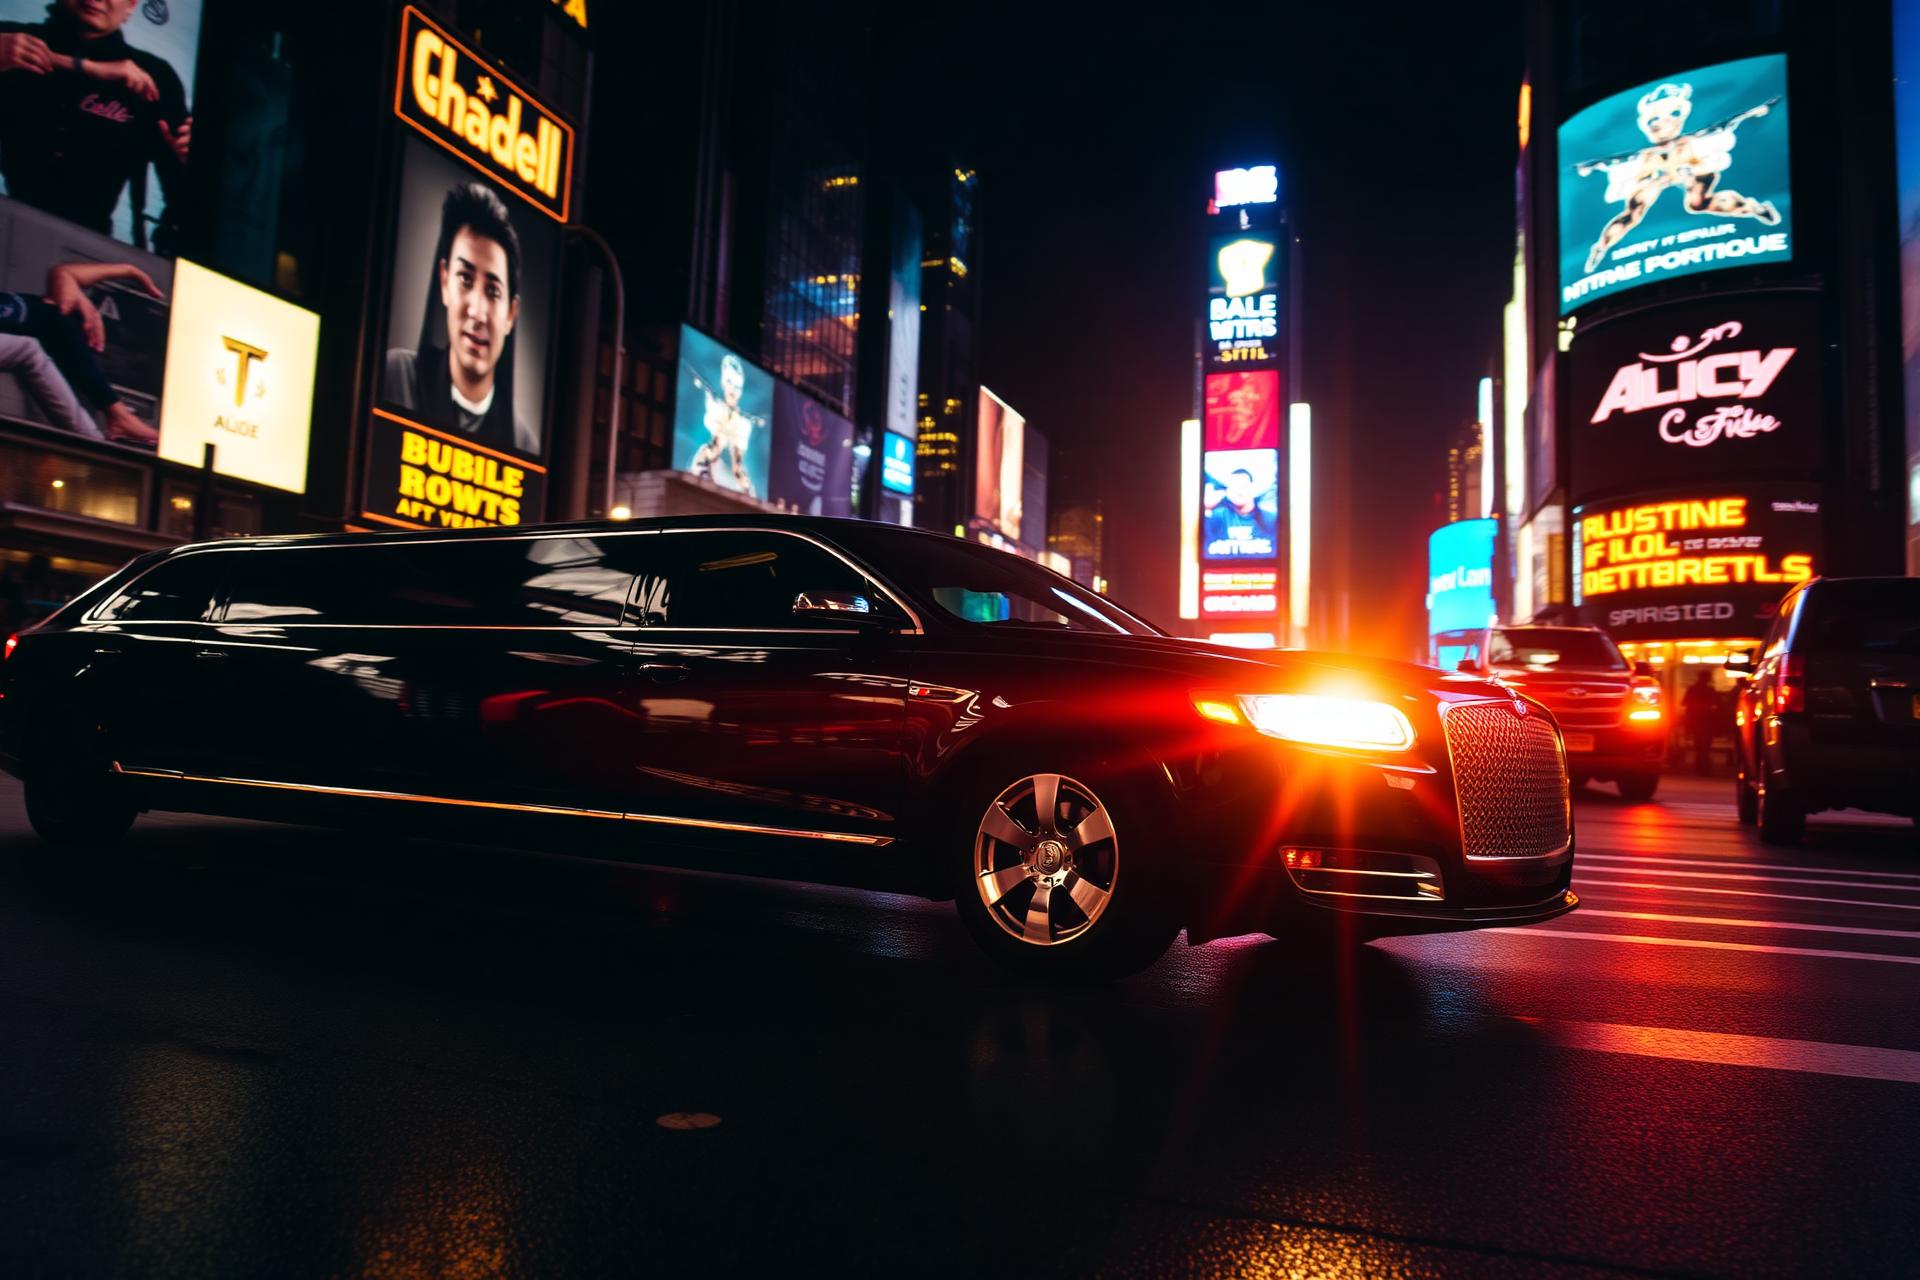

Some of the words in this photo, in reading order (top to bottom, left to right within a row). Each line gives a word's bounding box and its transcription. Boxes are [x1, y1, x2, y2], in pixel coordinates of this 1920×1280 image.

[411, 28, 563, 200] Chadell
[1644, 232, 1789, 274] PORTIQUE
[1209, 294, 1277, 321] BALE
[1590, 347, 1798, 425] ALICY
[398, 463, 521, 527] ROWTS
[401, 430, 525, 498] BUBILE
